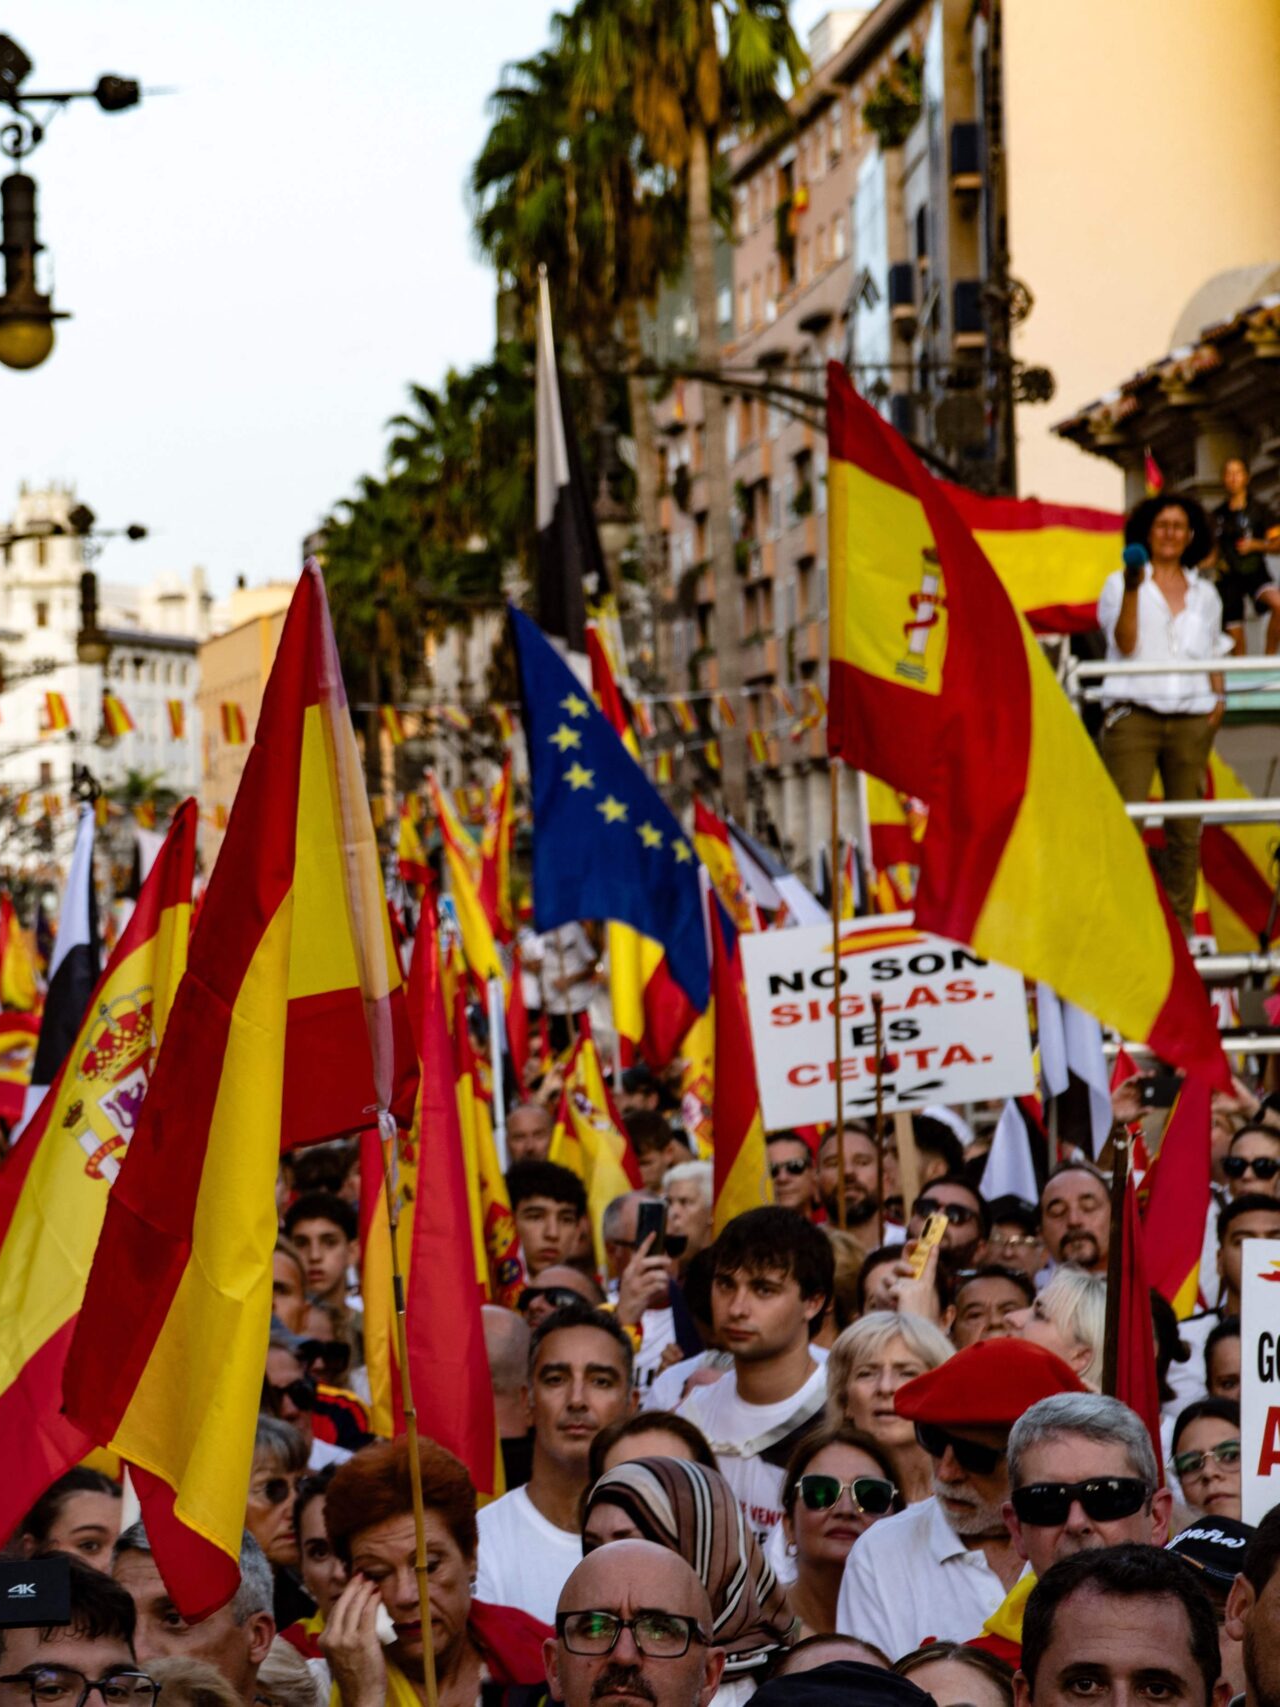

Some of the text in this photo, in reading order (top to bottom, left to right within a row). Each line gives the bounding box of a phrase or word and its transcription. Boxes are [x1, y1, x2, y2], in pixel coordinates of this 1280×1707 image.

[768, 950, 988, 995] NO SON
[852, 1018, 921, 1047] ES
[786, 1043, 994, 1088] CEUTA.
[8, 1583, 37, 1595] 4K
